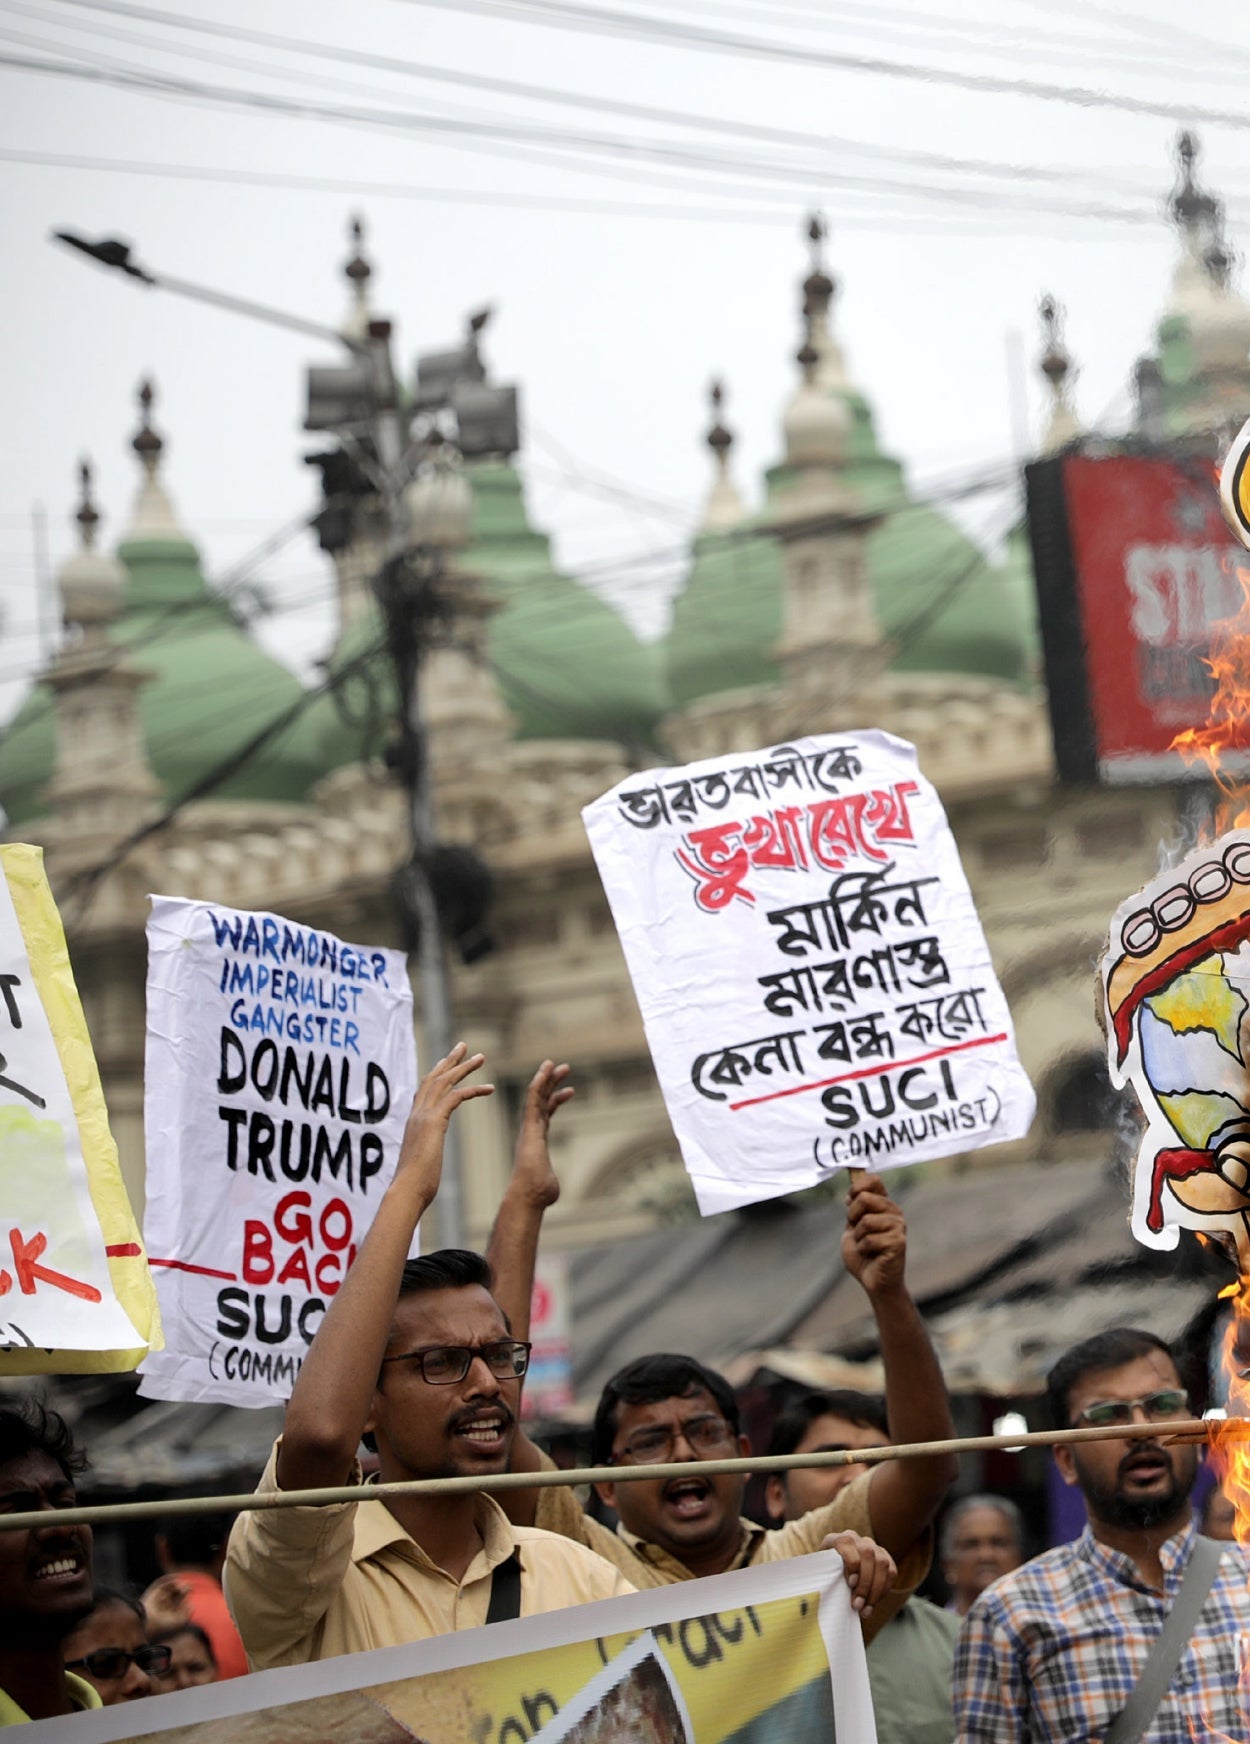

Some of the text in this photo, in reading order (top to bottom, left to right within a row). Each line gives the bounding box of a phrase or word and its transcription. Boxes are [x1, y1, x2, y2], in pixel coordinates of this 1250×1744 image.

[618, 745, 865, 830] ভারতবাসীকে
[766, 861, 940, 957] মার্কিন
[206, 910, 390, 989] WARMONGER
[219, 958, 363, 1016] IMPERIALIST
[757, 936, 951, 1018] মারণাস্ত্র
[230, 997, 362, 1057] GANGSTER
[691, 987, 989, 1101] কেনা বন্ধ করো
[216, 1025, 391, 1125] DONALD
[820, 1058, 959, 1130] SUCI
[218, 1105, 384, 1197] TRUMP
[813, 1085, 1001, 1169] (COMMUNIST)
[242, 1219, 358, 1297] BAC
[273, 1190, 354, 1252] GO
[208, 1341, 303, 1388] (COMM
